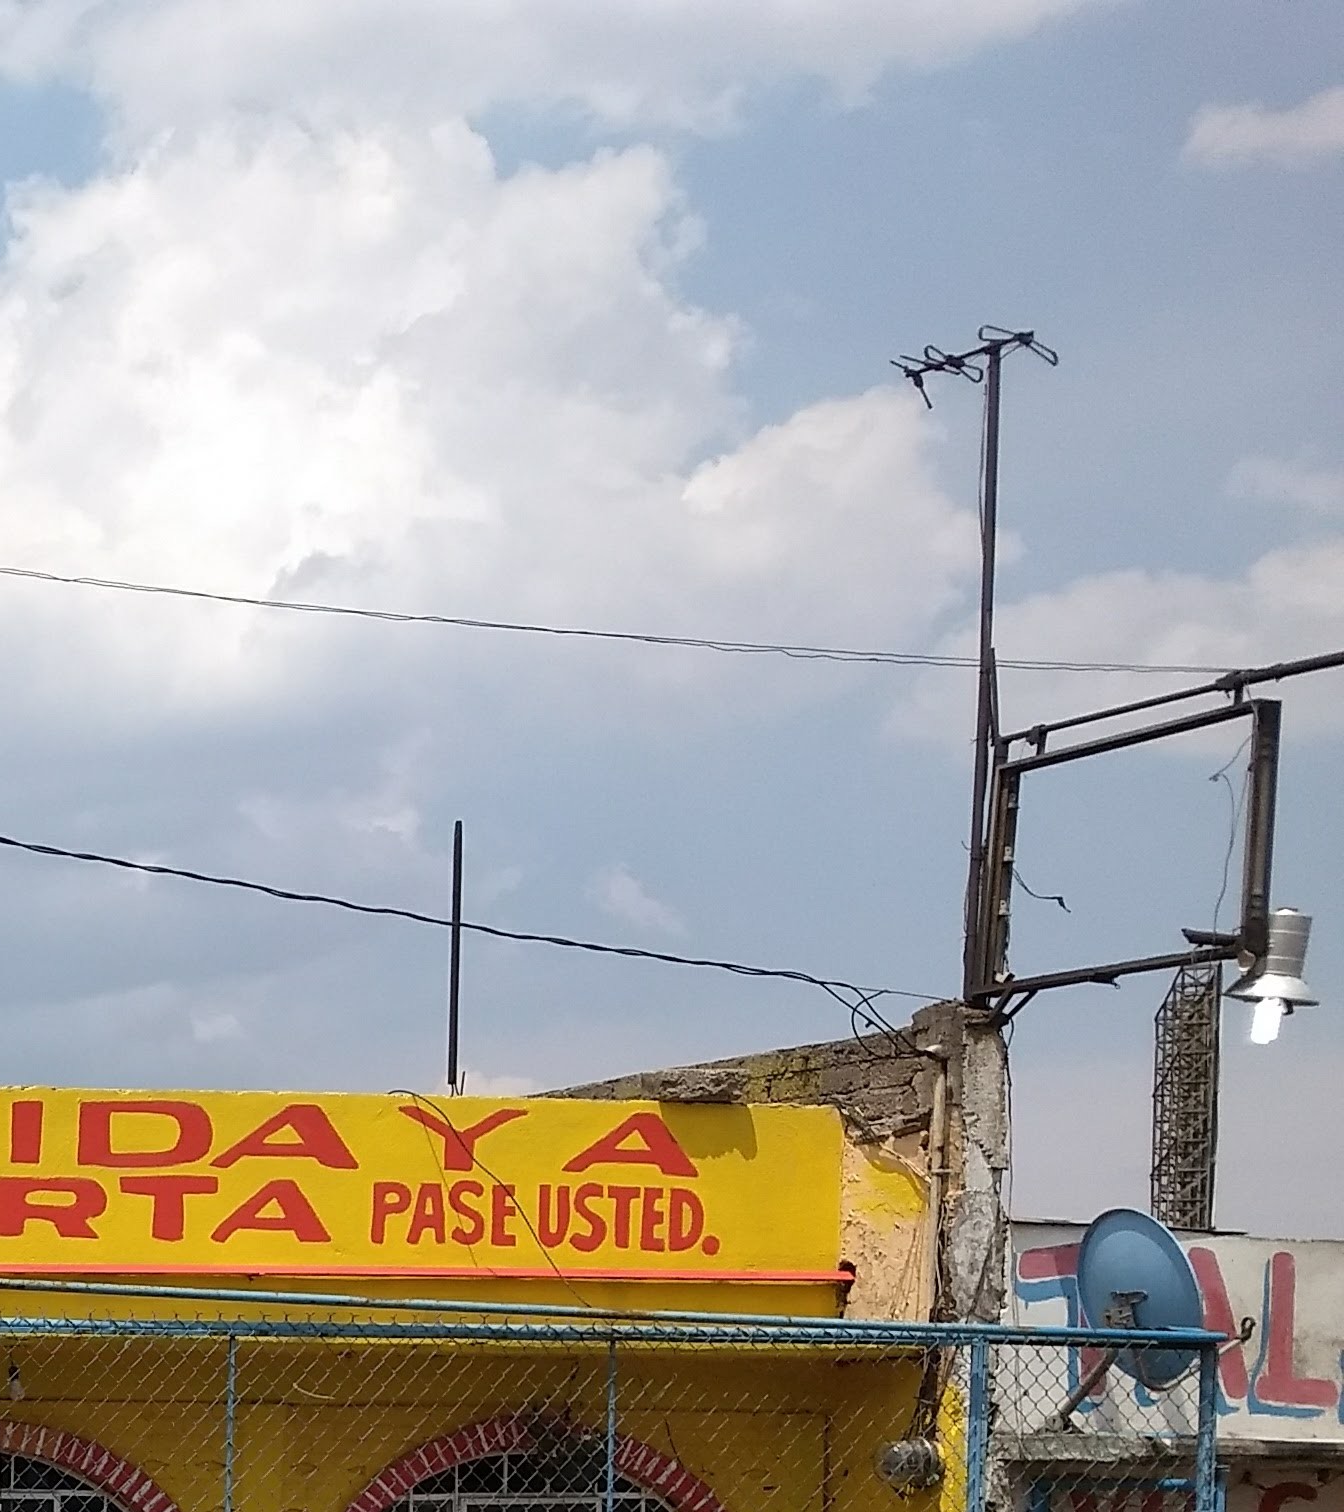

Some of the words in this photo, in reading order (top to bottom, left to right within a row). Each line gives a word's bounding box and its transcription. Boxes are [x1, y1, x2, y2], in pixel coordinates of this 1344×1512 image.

[398, 1103, 529, 1172] Y
[561, 1110, 699, 1178] A
[370, 1180, 518, 1248] PASE
[536, 1182, 721, 1257] USTED.
